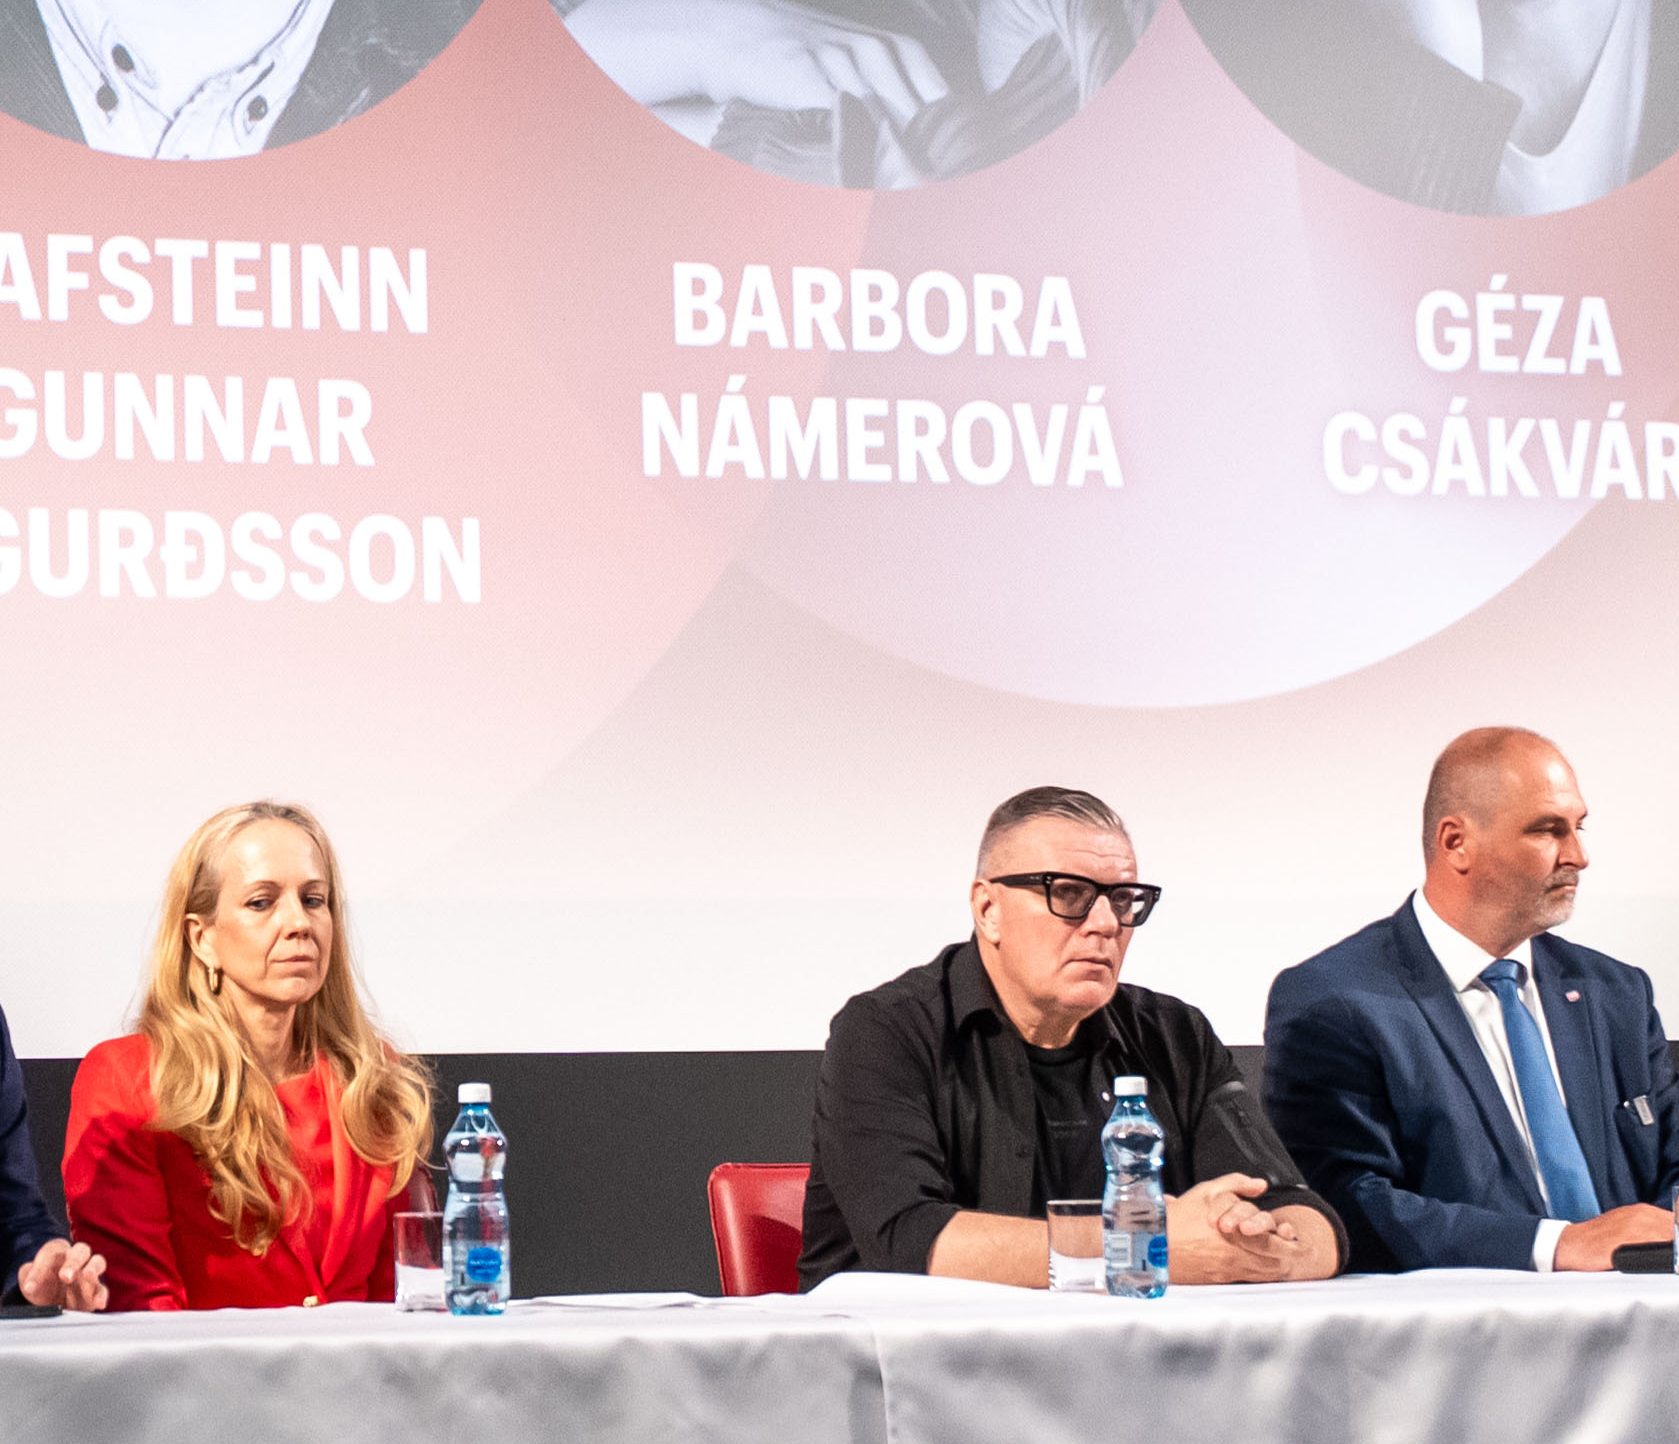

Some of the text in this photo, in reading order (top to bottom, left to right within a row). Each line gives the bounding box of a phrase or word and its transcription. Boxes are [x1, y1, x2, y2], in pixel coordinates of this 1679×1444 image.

[672, 260, 1087, 359] BARBORA
[1413, 274, 1623, 377] GÉZA
[640, 374, 1125, 490] NÁMEROVÁ
